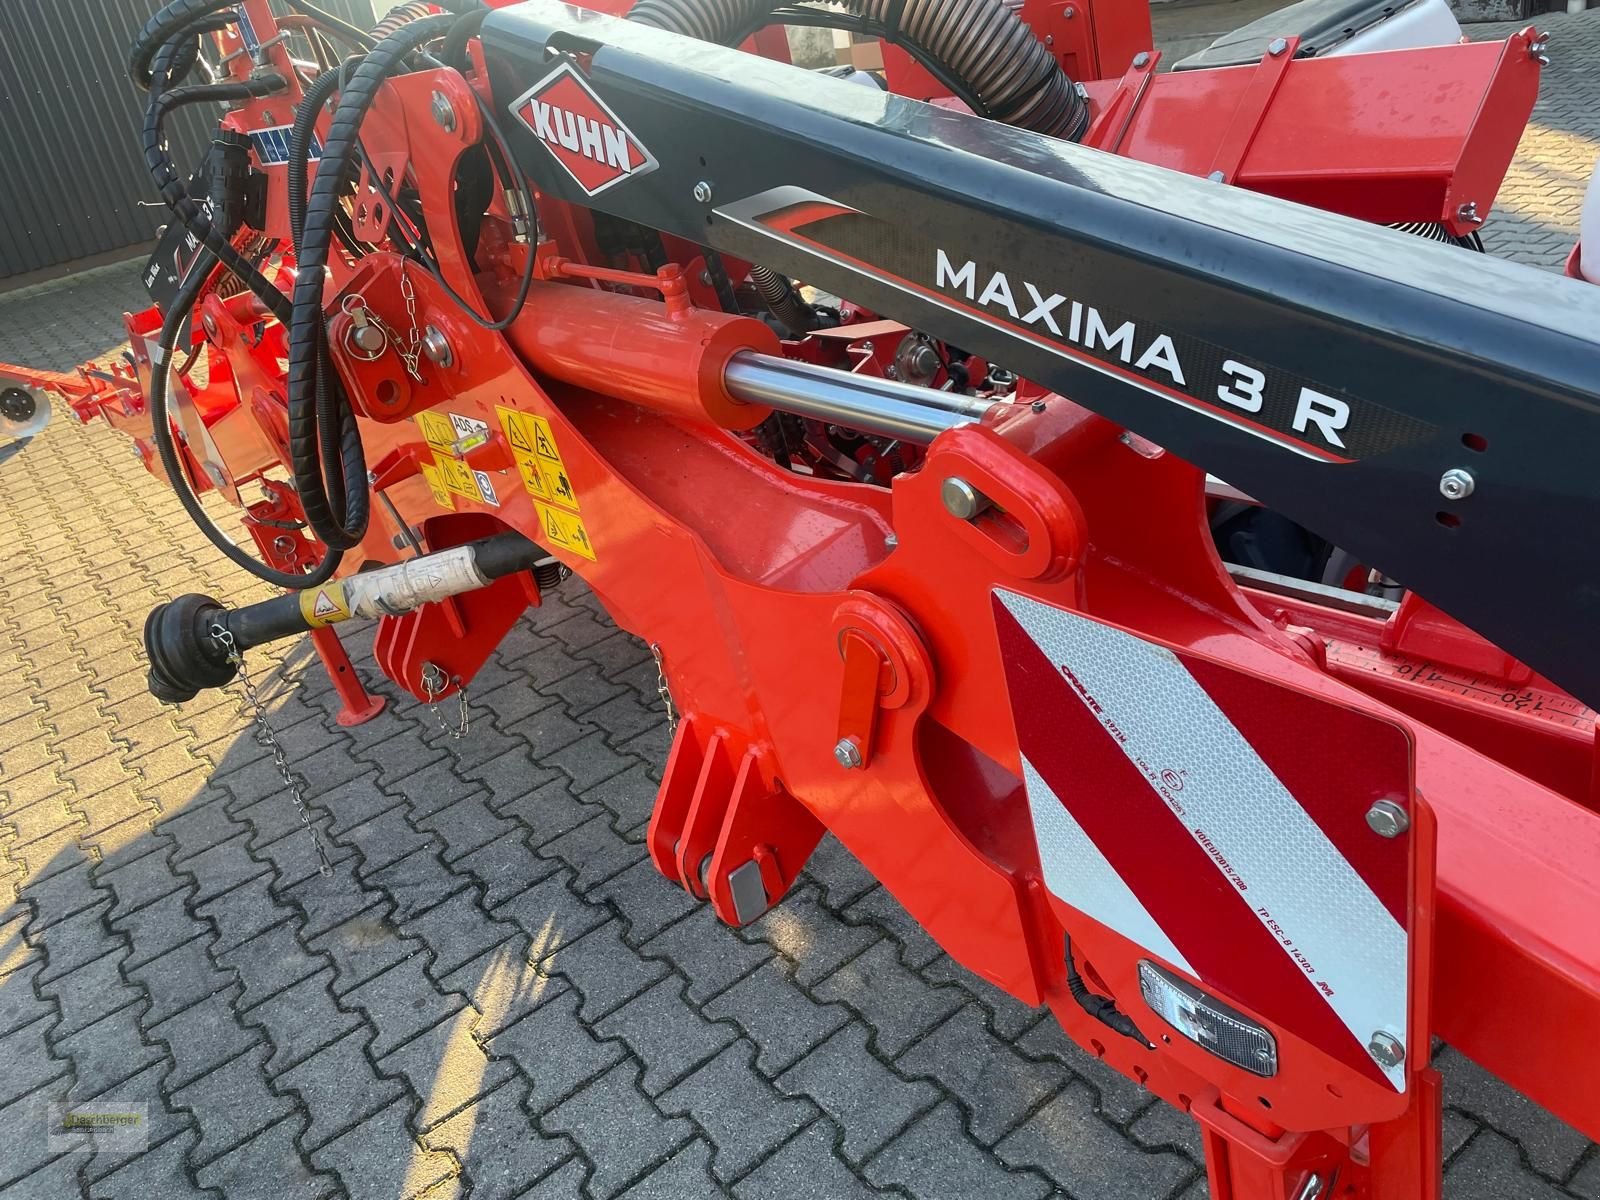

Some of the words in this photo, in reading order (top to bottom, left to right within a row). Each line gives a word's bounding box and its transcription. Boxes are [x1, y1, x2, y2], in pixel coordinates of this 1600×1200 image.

[530, 98, 631, 174] KUHN
[936, 248, 1187, 386] MAXIMA
[1217, 359, 1266, 413] 3
[1291, 387, 1351, 449] R
[453, 416, 474, 433] ADS
[1061, 665, 1103, 714] ORALITE
[1105, 718, 1127, 743] 5921M
[1258, 907, 1270, 918] TP
[1267, 919, 1293, 946] ESC-B
[1291, 948, 1315, 974] 14303
